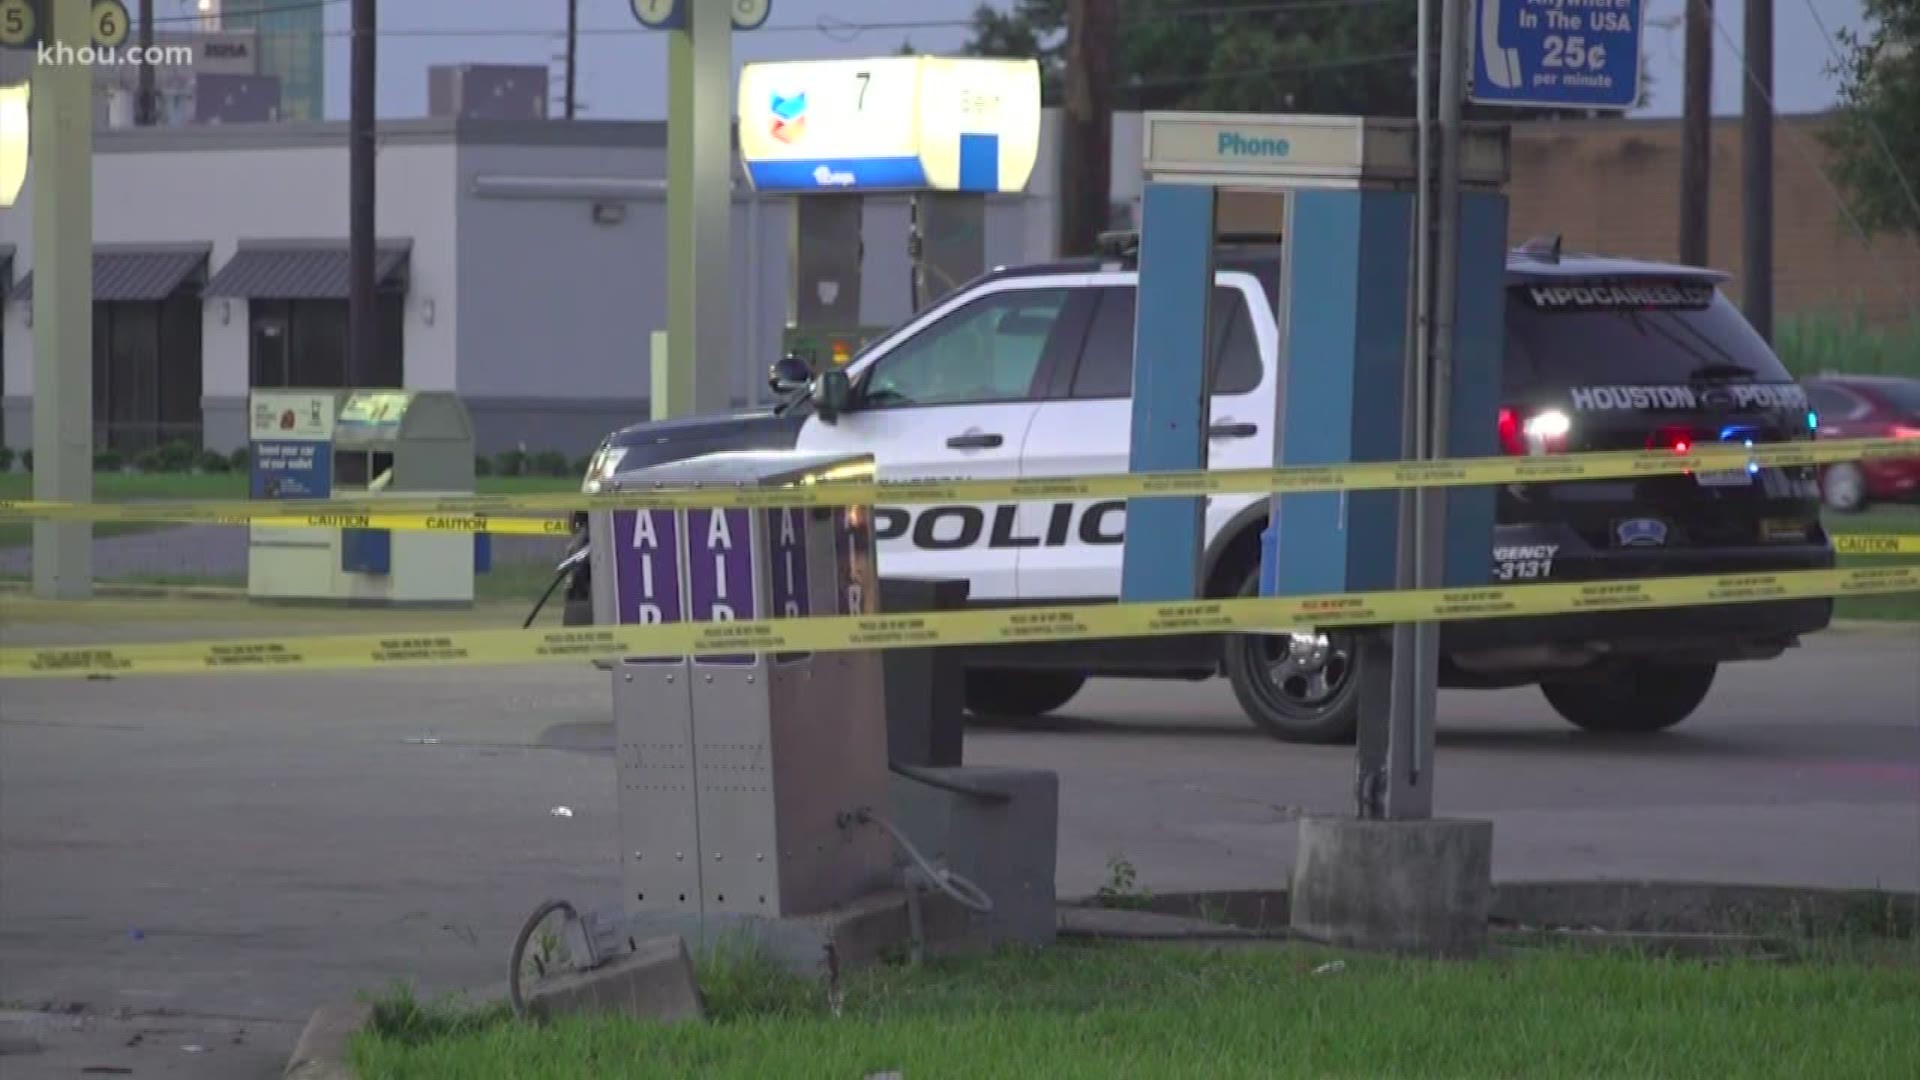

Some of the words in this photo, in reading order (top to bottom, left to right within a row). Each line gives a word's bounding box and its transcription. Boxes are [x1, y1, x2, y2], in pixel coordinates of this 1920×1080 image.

[6, 9, 23, 34] 5
[100, 12, 115, 36] 6
[1519, 9, 1537, 29] In
[1545, 10, 1582, 30] The
[1590, 12, 1632, 31] USA
[1541, 35, 1607, 71] 25¢
[856, 72, 871, 111] 7
[1533, 73, 1556, 88] per
[1562, 72, 1613, 88] minute
[1217, 132, 1290, 156] Phone
[1570, 383, 1697, 409] HOUSTON
[307, 514, 370, 528] CAUTION
[426, 516, 488, 531] CAUTION
[873, 501, 1126, 550] POLIC
[1493, 544, 1560, 561] GENCY
[1838, 537, 1900, 551] CAUTION
